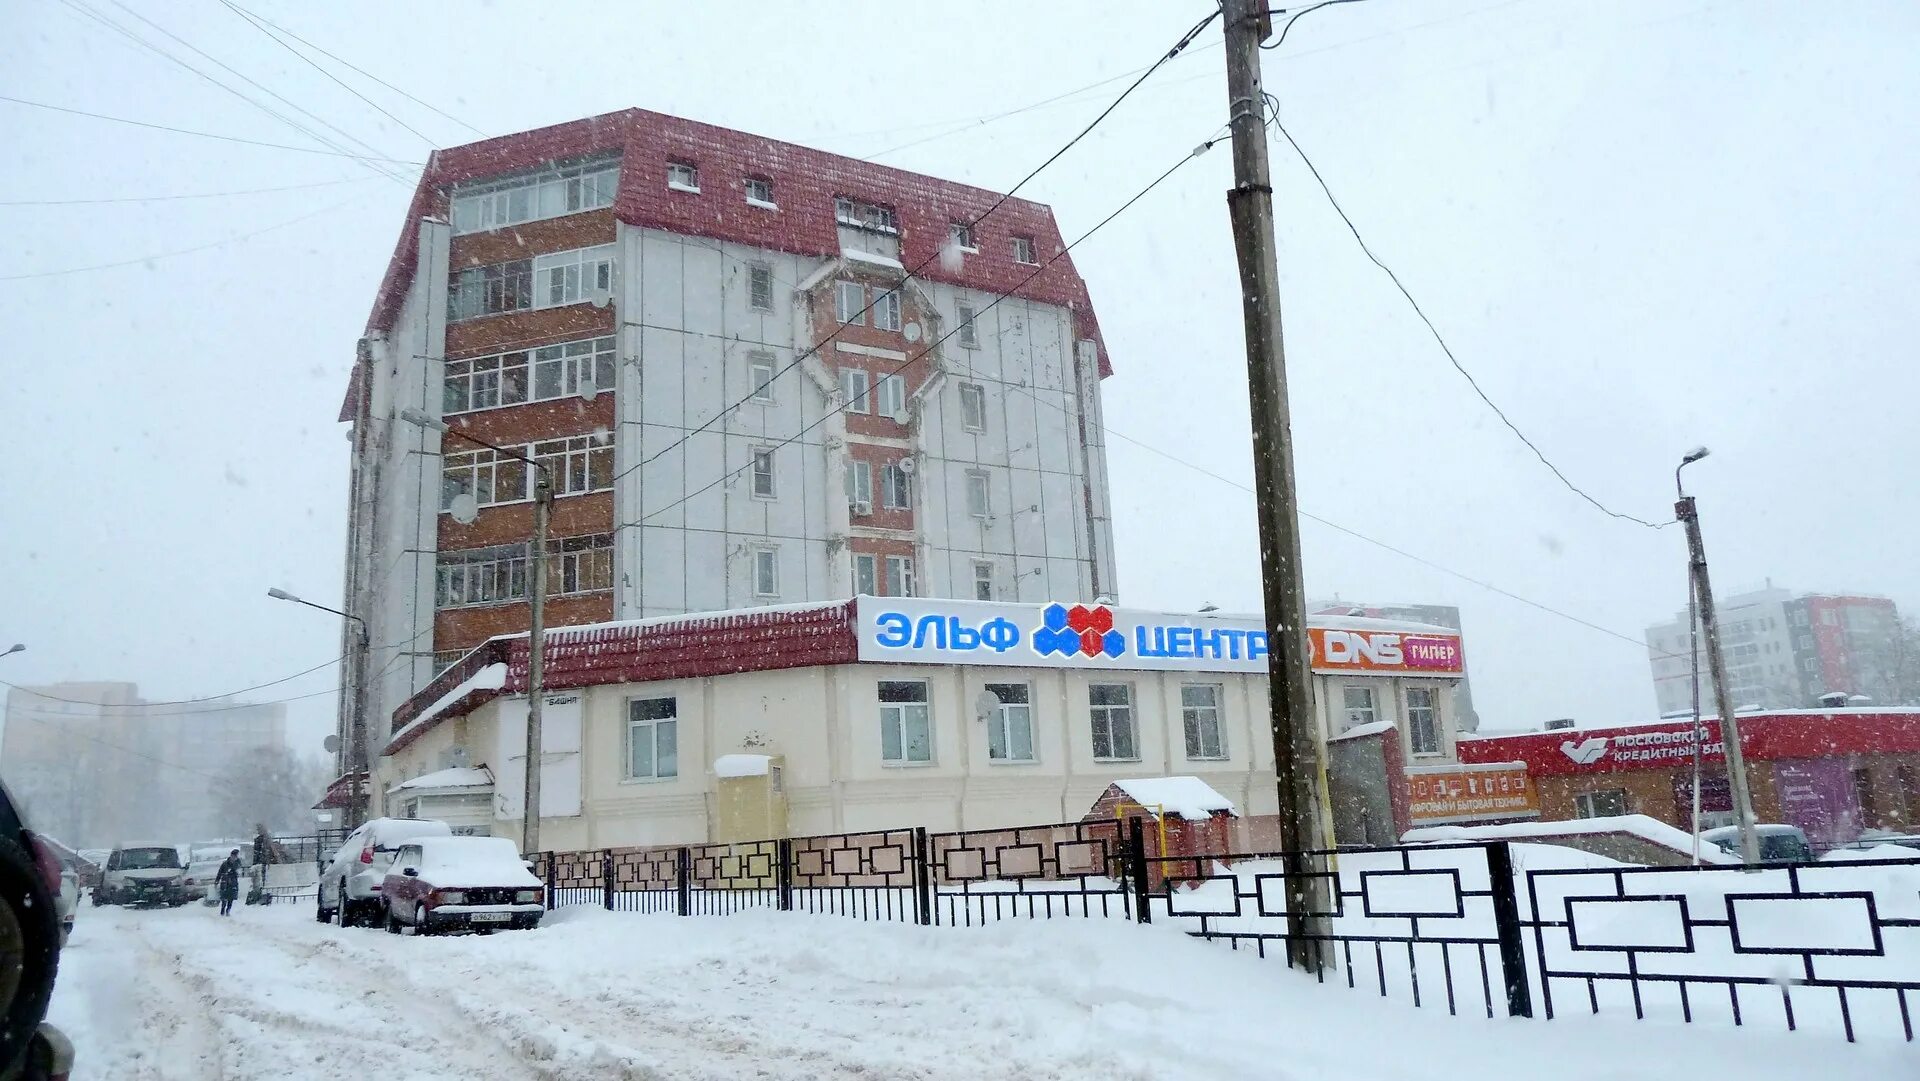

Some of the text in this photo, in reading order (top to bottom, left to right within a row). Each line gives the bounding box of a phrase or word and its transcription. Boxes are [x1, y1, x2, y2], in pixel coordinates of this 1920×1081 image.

[875, 612, 1268, 661] ЭЛЬФ ЦЕНТР
[1323, 630, 1404, 665] DNS
[1411, 644, 1455, 661] ГИПЕР
[1613, 743, 1698, 762] КРЕДИТНЫЙ
